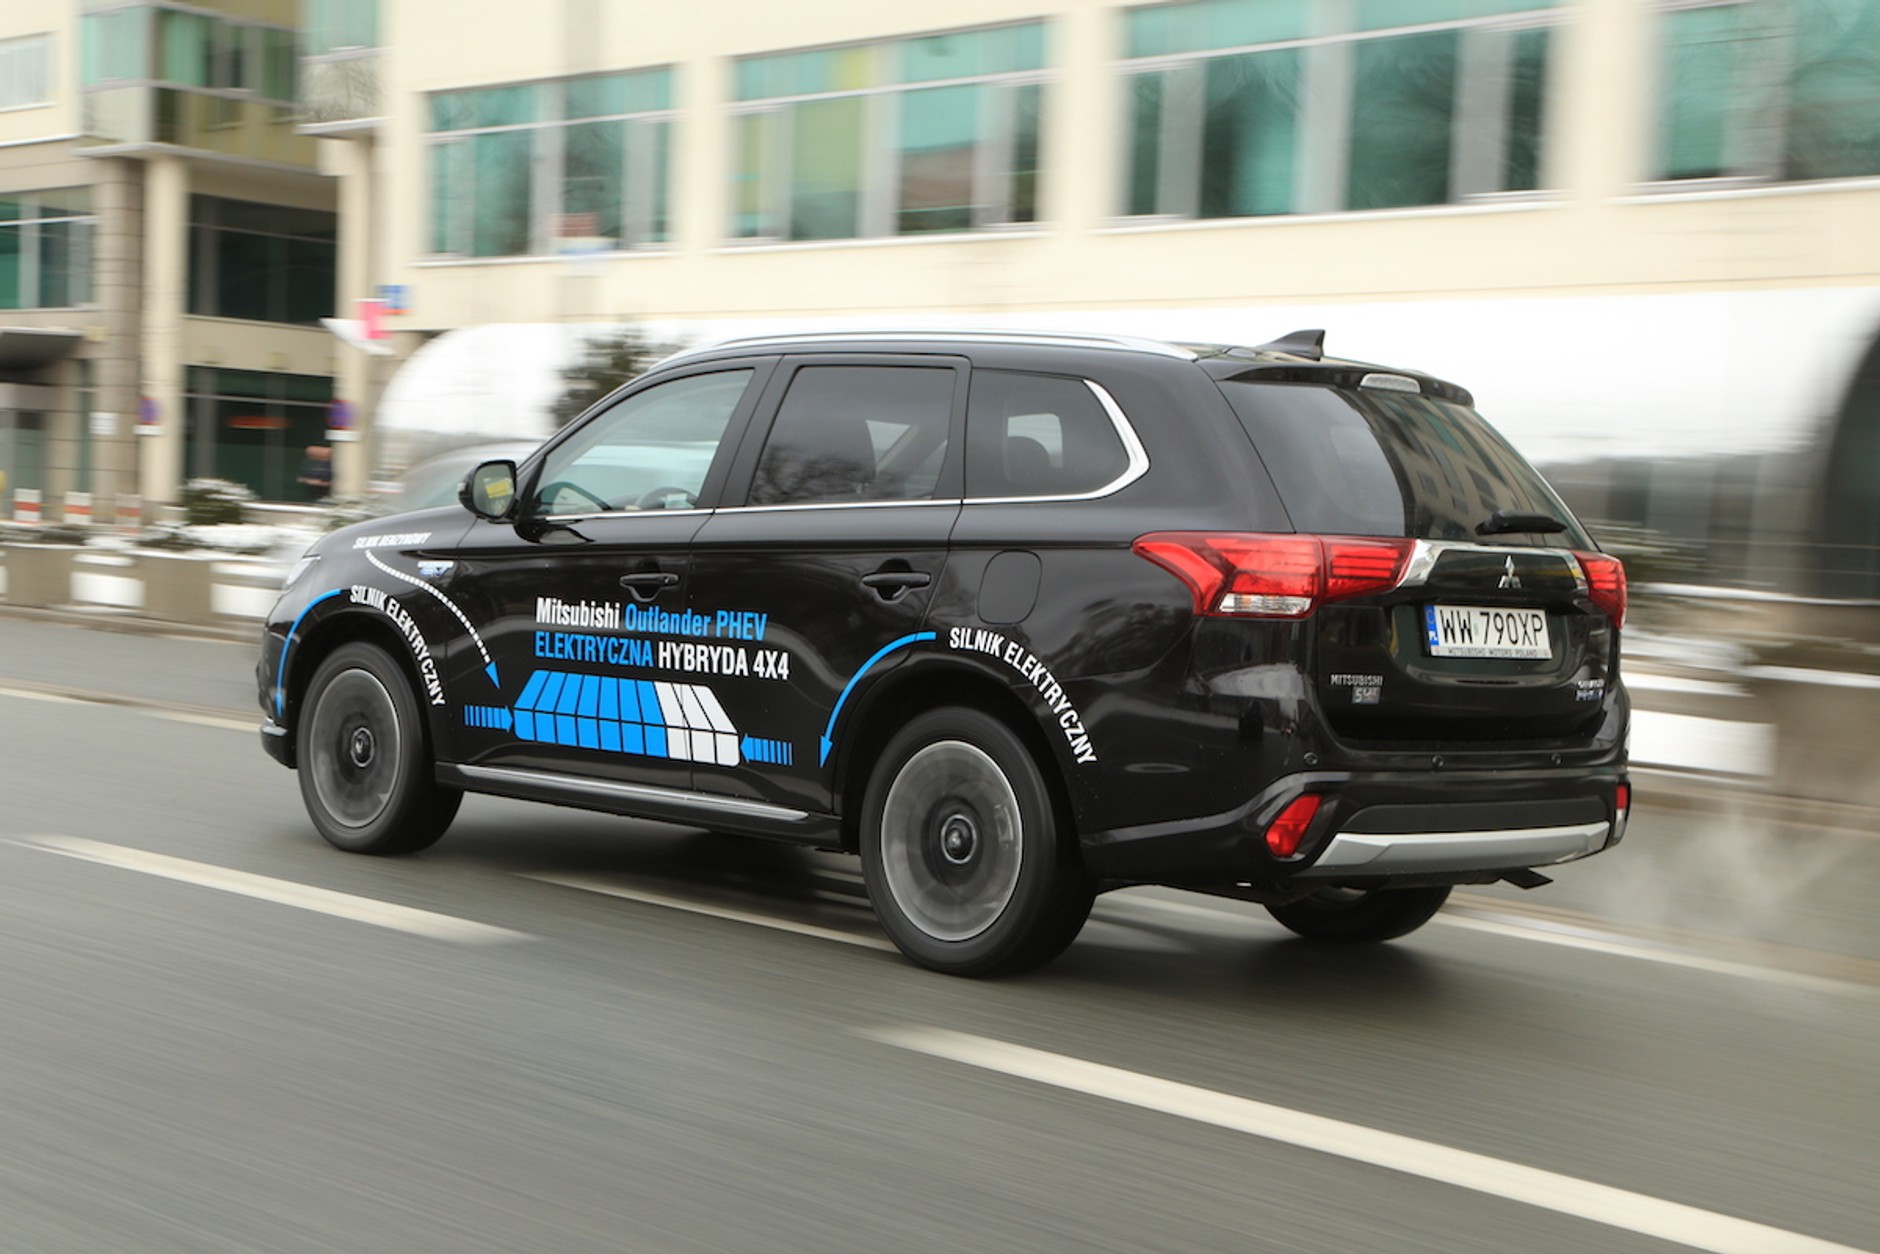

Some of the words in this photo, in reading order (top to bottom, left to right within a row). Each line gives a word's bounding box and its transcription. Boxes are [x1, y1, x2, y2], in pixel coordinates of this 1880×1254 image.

[536, 597, 620, 630] Mitsubishi
[624, 603, 711, 637] Outlander
[715, 610, 768, 641] PHEV
[1440, 609, 1473, 644] WW
[1480, 611, 1543, 646] 790XP
[349, 584, 388, 611] SILNIK
[386, 597, 446, 706] ELEKTRYCZNY
[535, 631, 654, 667] ELEKTRYCZNA
[658, 641, 749, 676] HYBRYDA
[752, 650, 790, 680] 4X4
[949, 627, 1005, 658] SILNIK
[1003, 641, 1098, 764] ELEKTRYCZNY
[1330, 674, 1383, 686] MITSUBISHI
